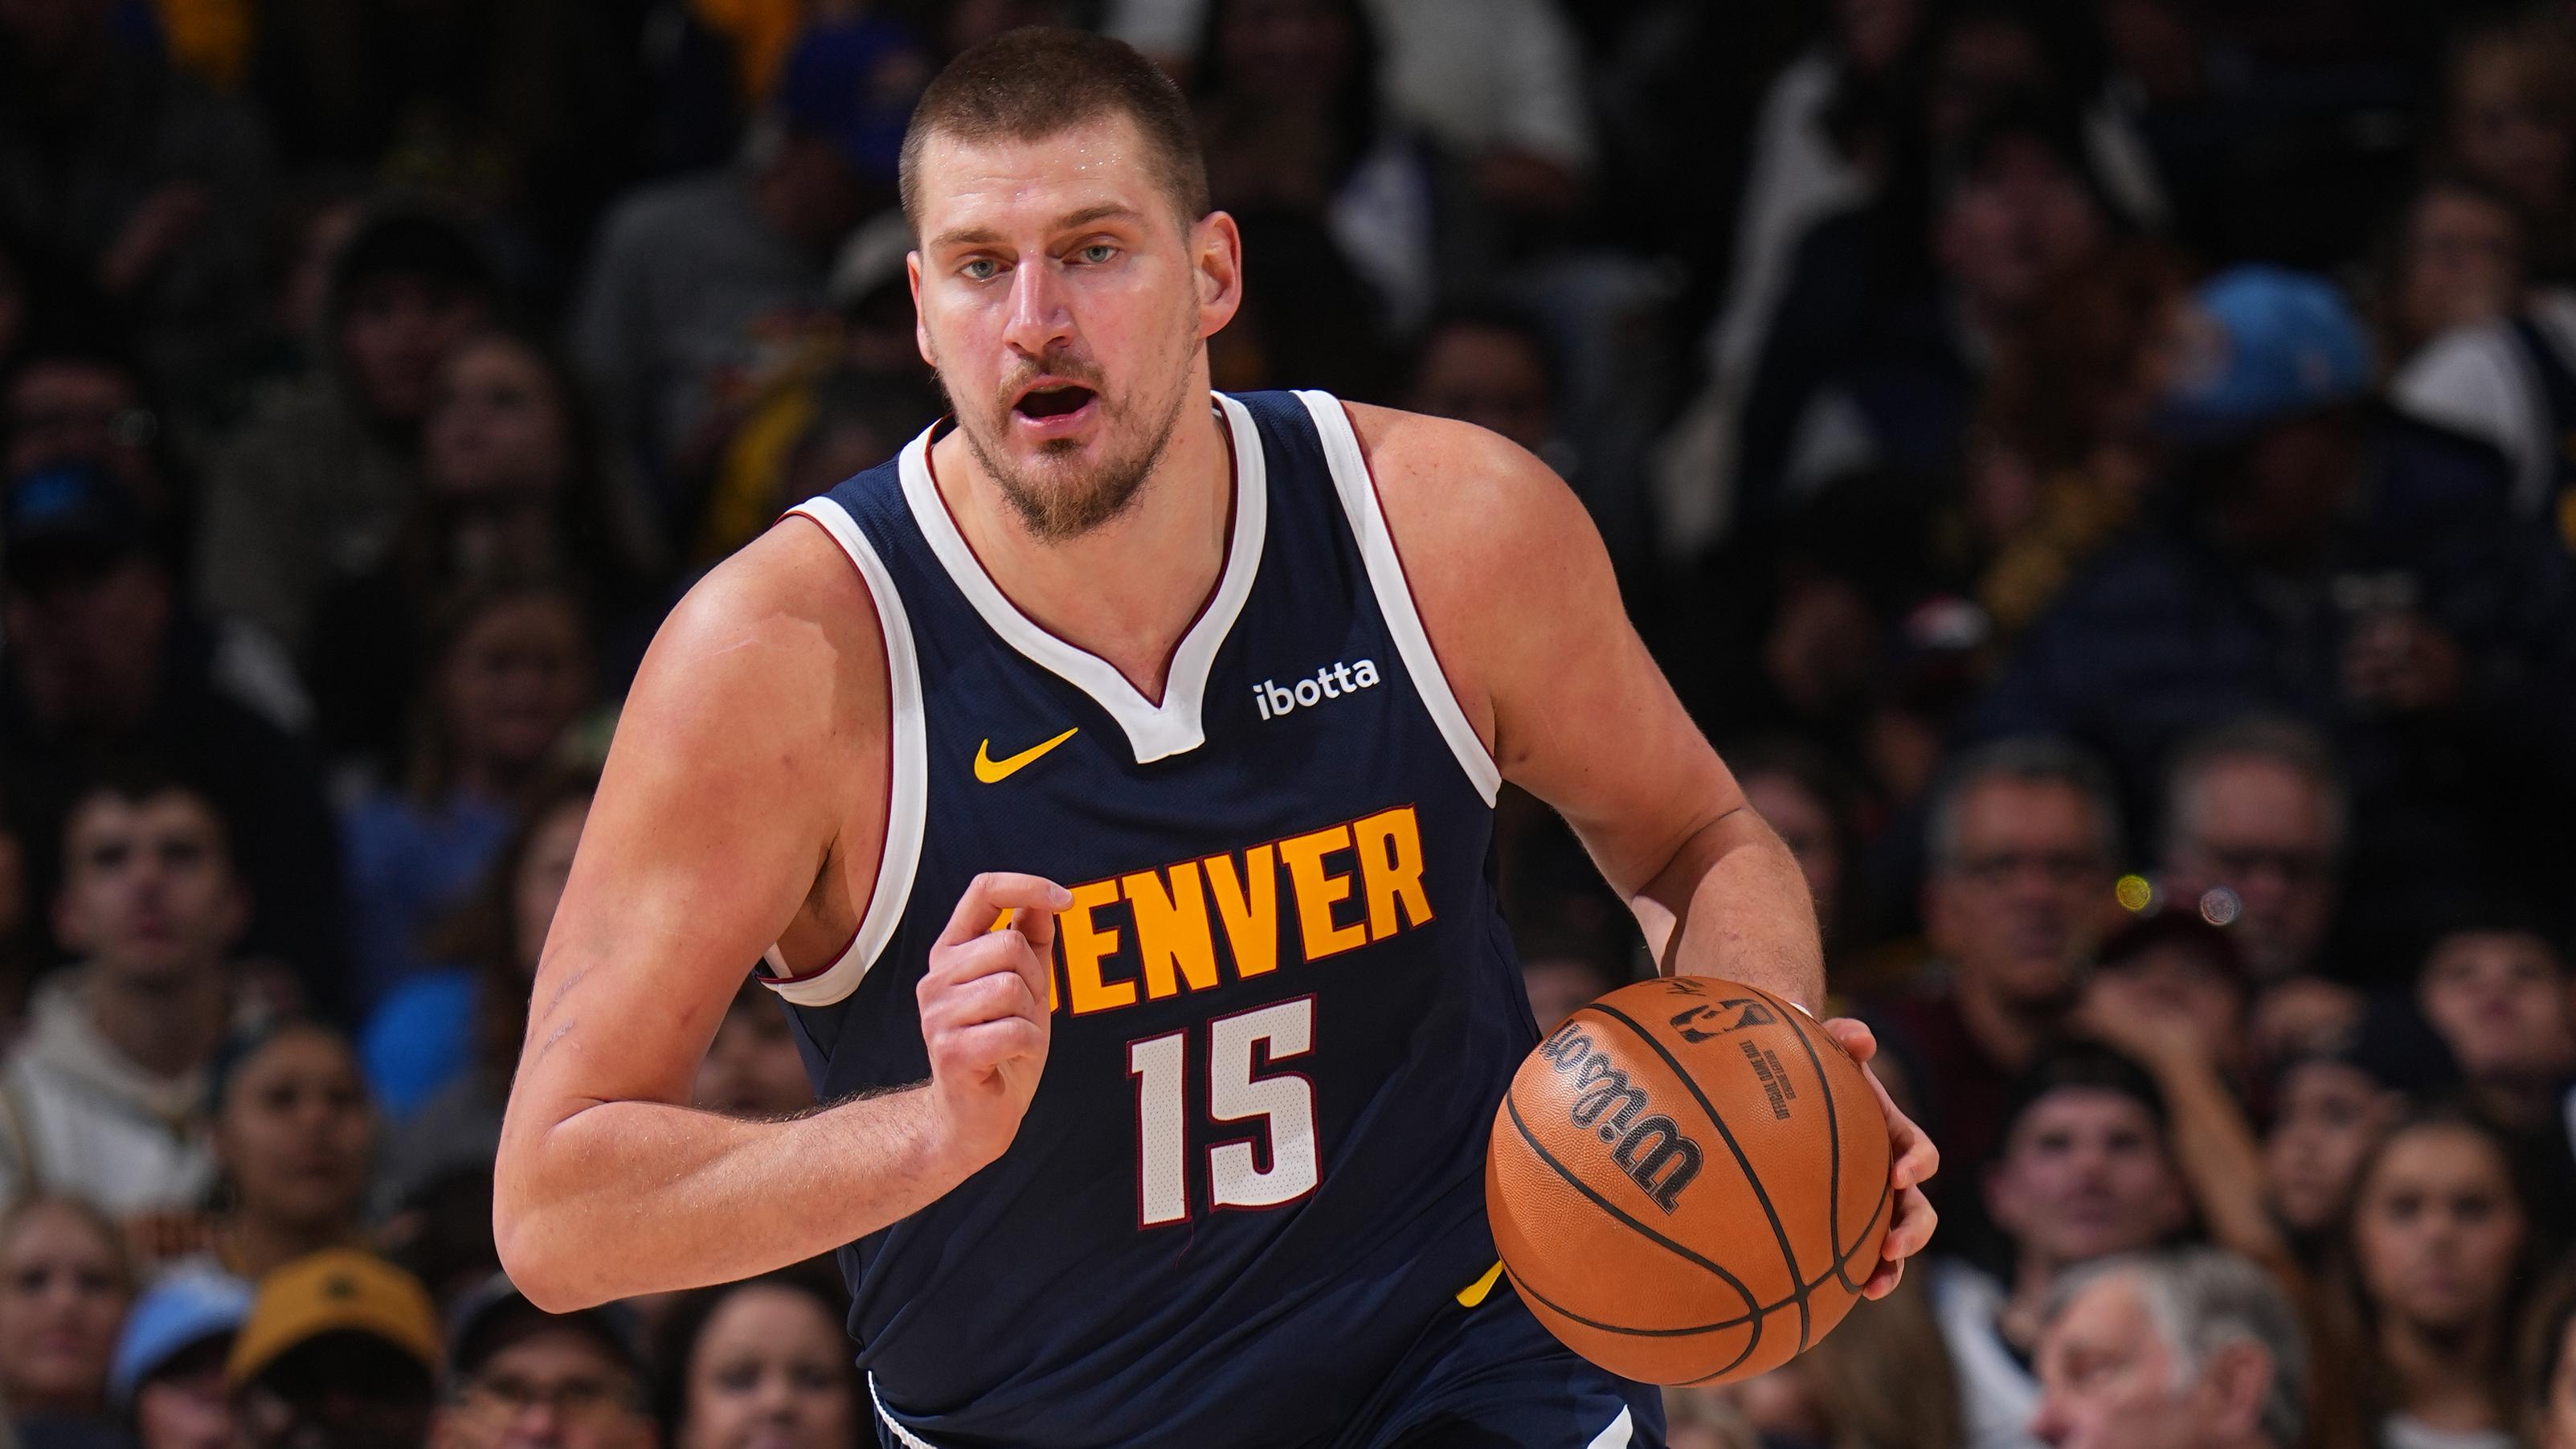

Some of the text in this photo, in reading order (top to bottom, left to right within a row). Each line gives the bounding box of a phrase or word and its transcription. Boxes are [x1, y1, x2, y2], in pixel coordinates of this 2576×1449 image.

[1253, 659, 1380, 721] ibotta
[990, 804, 1435, 1017] ENVER
[1126, 993, 1323, 1231] 15
[1539, 1019, 1703, 1214] Wilson
